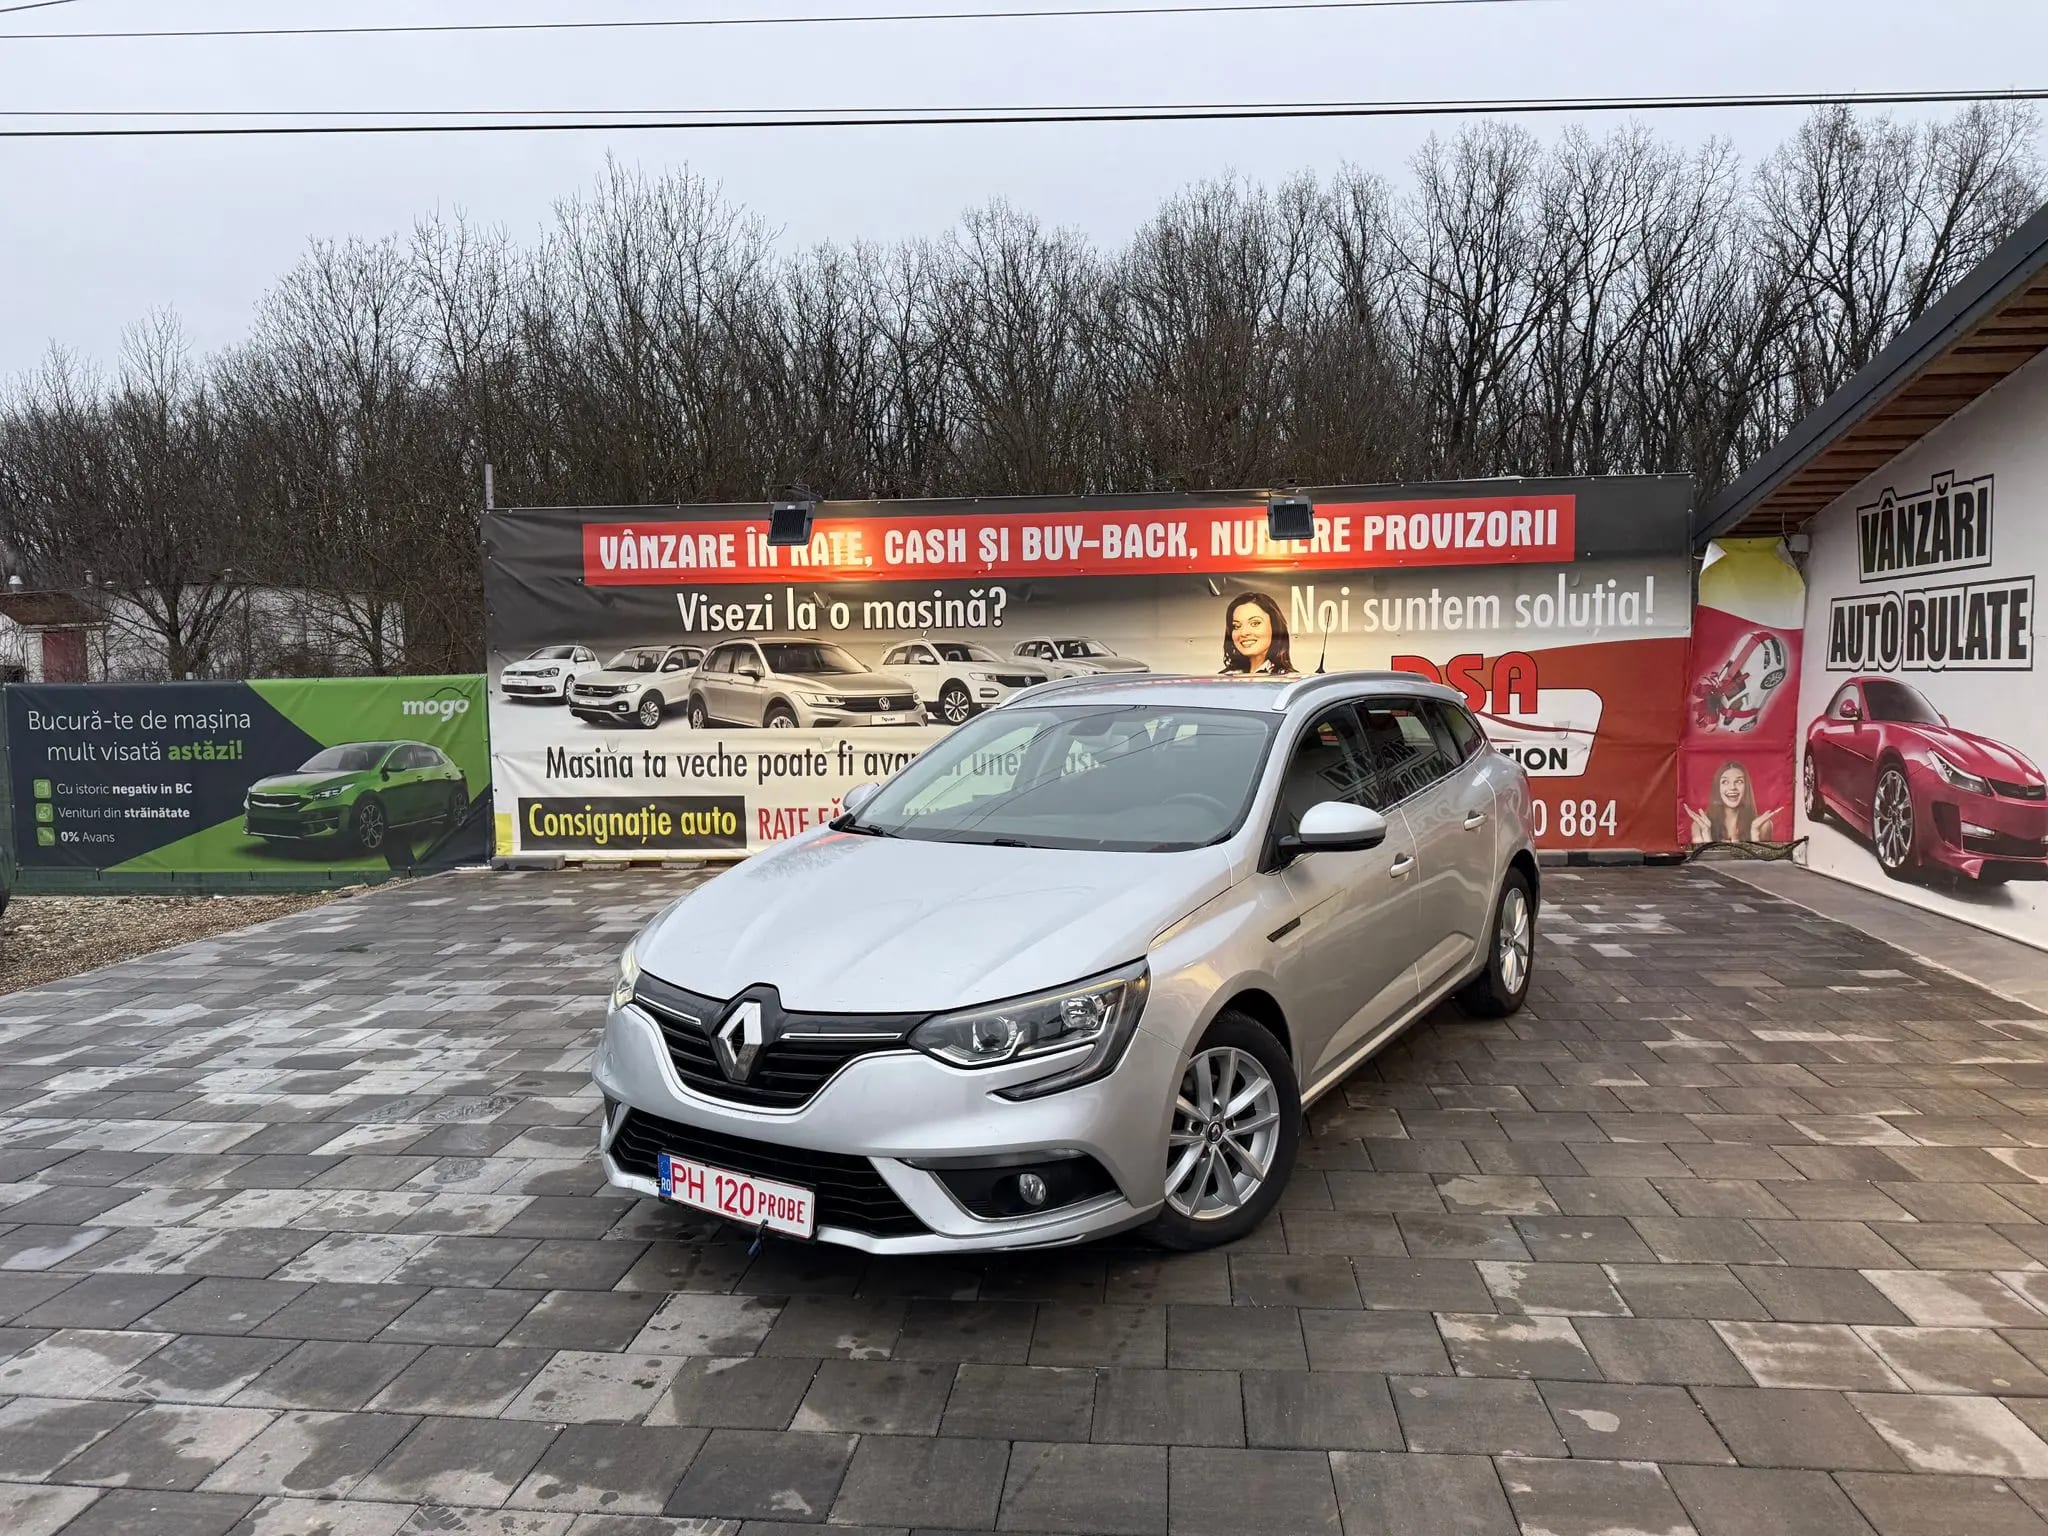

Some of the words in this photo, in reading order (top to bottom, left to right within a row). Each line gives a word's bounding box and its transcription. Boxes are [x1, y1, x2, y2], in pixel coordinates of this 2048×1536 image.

[600, 529, 736, 569] VÂNZARE
[745, 526, 778, 568] ÎN
[790, 531, 873, 568] RATE,
[884, 528, 967, 564] CASH
[978, 527, 1009, 571] ȘI
[1022, 521, 1198, 562] BUY-BACK,
[1363, 509, 1558, 551] PROVIZORII
[1861, 483, 1988, 573] VÂNZĂRI
[676, 592, 774, 632] Visezi
[785, 587, 817, 631] la
[829, 600, 851, 630] o
[863, 586, 1007, 637] mașină?
[1291, 585, 1350, 634] Noi
[1363, 588, 1500, 633] suntem
[1514, 572, 1655, 637] soluția!
[1831, 601, 1900, 664] AUTO
[1906, 587, 2029, 663] RULATE
[28, 710, 134, 731] Bucură-te
[140, 709, 167, 730] de
[174, 708, 251, 733] mașina
[402, 699, 470, 722] mogo
[47, 741, 96, 761] mult
[100, 741, 162, 761] visată
[167, 740, 243, 761] astăzi!
[642, 750, 667, 778] ta
[676, 742, 748, 779] veche
[757, 749, 828, 785] poate
[838, 740, 855, 777] fi
[864, 751, 920, 776] ava
[56, 784, 73, 794] Cu
[75, 783, 109, 794] istoric
[112, 783, 158, 797] negativ
[160, 783, 172, 794] in
[175, 783, 192, 794] BC
[58, 807, 101, 818] Venituri
[104, 807, 121, 818] din
[124, 807, 190, 818] străinătate
[528, 803, 673, 844] Consignație
[680, 806, 737, 836] auto
[758, 807, 810, 840] RATE
[1559, 799, 1618, 837] 884
[60, 831, 80, 842] 0%
[82, 831, 115, 843] Avans
[661, 1177, 672, 1192] RO
[671, 1162, 705, 1203] PH
[715, 1175, 755, 1217] 120
[758, 1191, 806, 1224] PROBE
